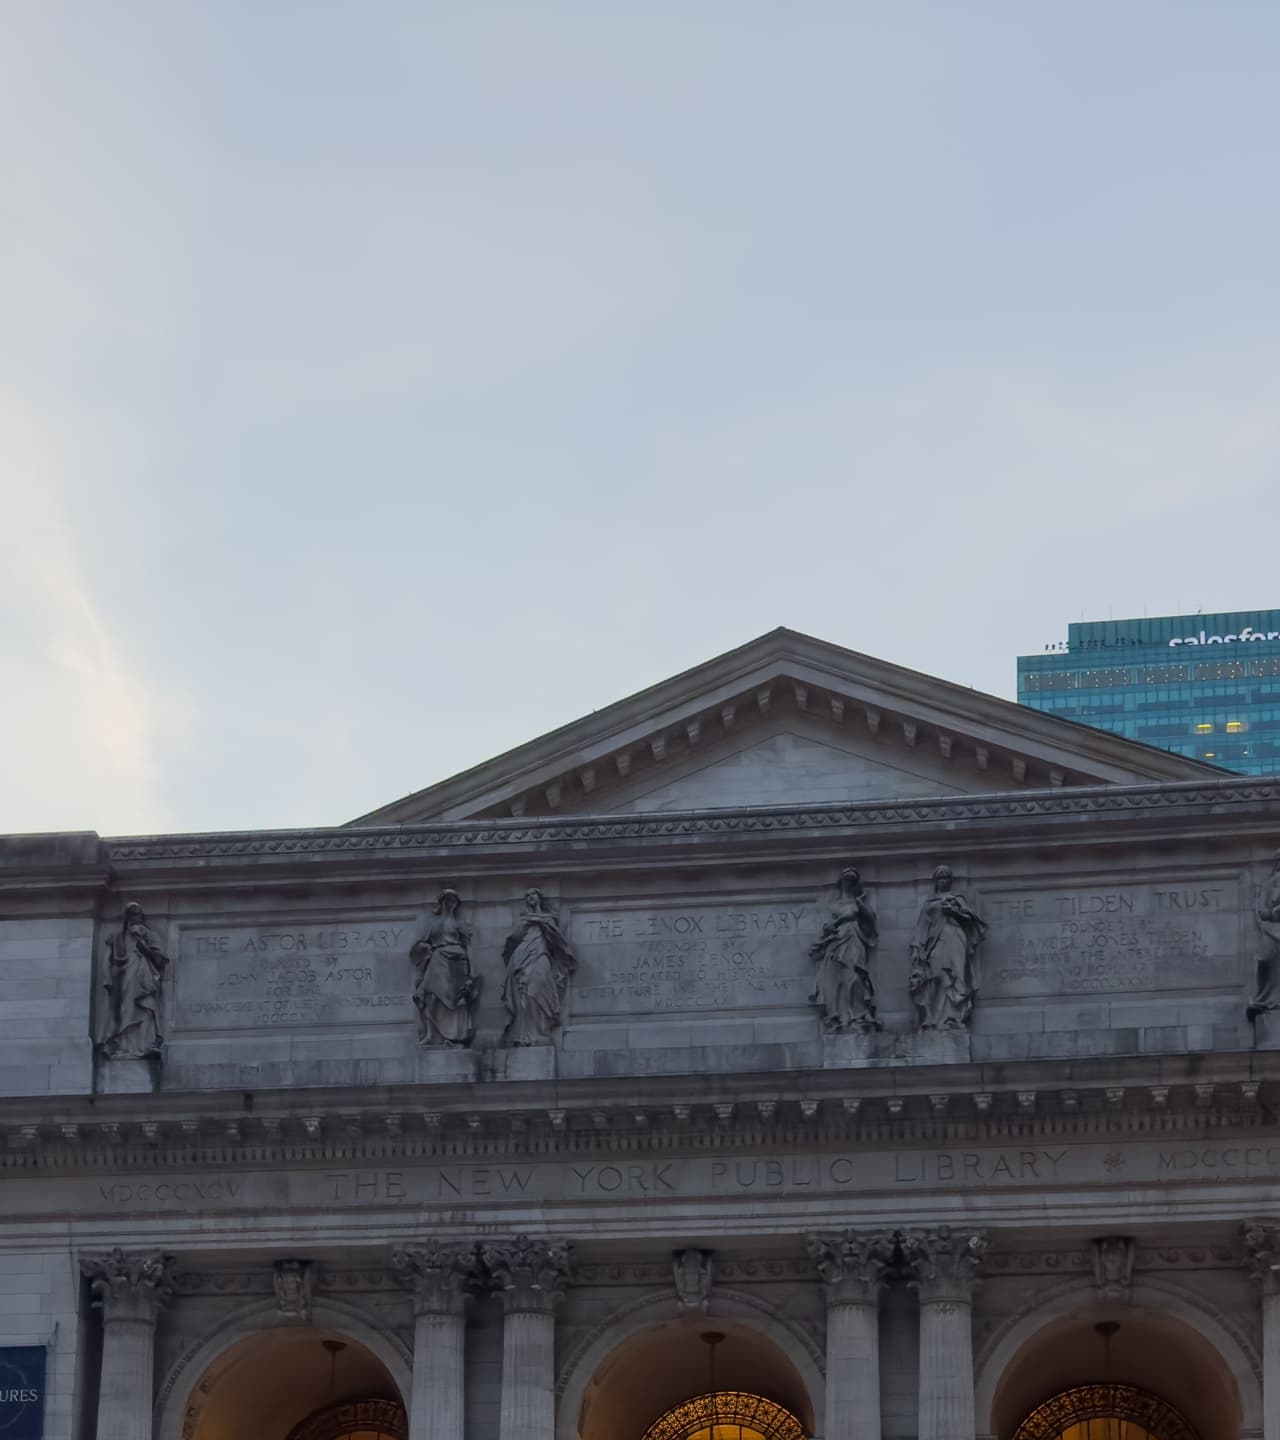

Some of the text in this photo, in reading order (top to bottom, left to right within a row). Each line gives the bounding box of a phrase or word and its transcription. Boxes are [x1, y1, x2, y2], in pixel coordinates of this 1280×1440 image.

[1056, 895, 1134, 914] TILDEN
[1152, 888, 1224, 910] TRUST
[324, 967, 373, 983] ASTOR
[327, 1171, 406, 1199] THE
[438, 1167, 536, 1197] NEW
[571, 1163, 677, 1193] YORK
[710, 1157, 854, 1188] PUBLIC
[895, 1149, 1070, 1183] LIBRARY
